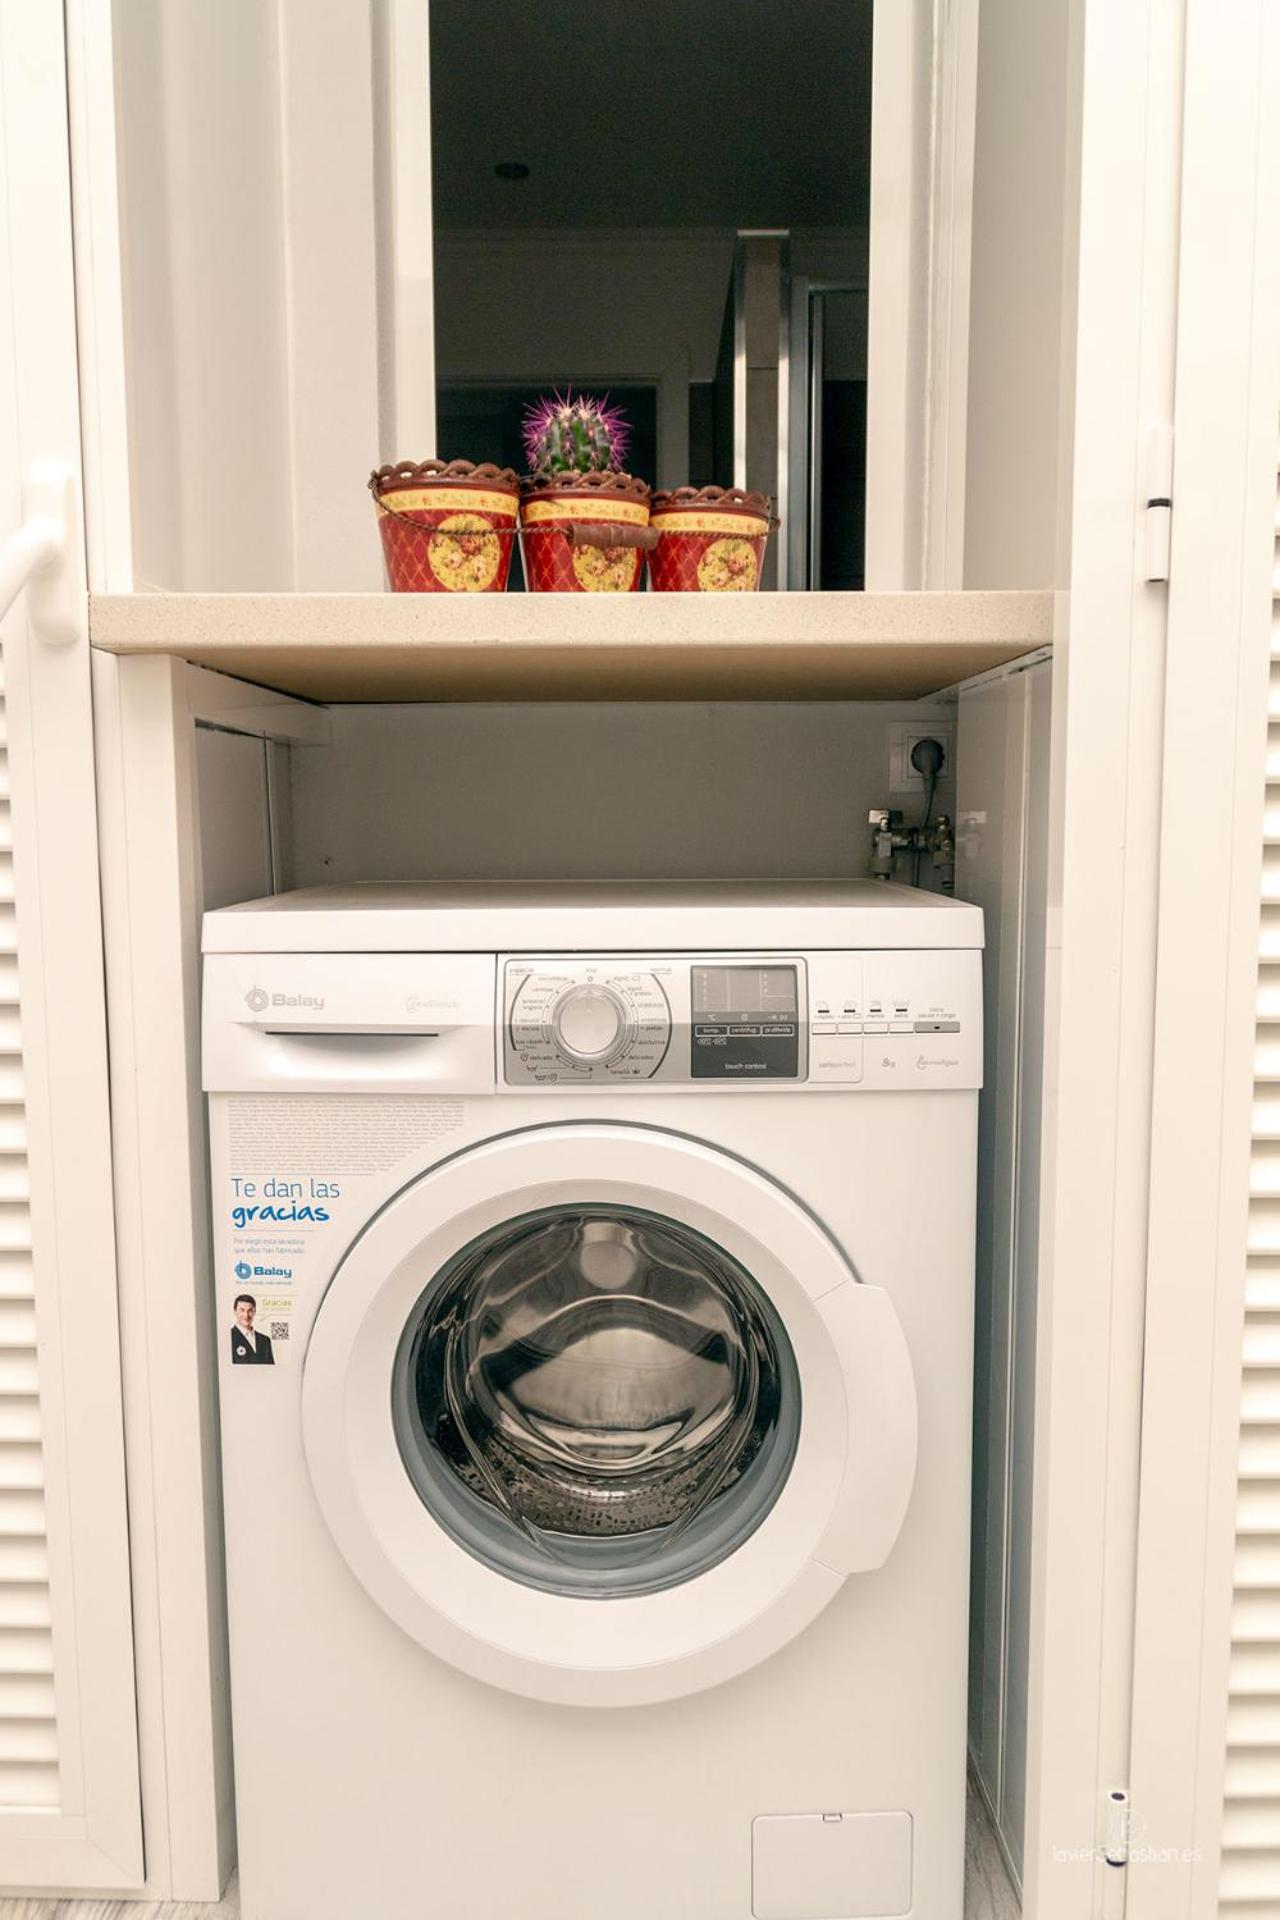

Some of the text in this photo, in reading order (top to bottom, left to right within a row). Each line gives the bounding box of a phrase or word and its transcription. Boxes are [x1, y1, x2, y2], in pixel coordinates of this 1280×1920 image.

[271, 993, 325, 1010] Balay
[230, 1177, 340, 1199] Te dan las
[232, 1200, 330, 1228] gracias
[253, 1266, 292, 1278] Balay
